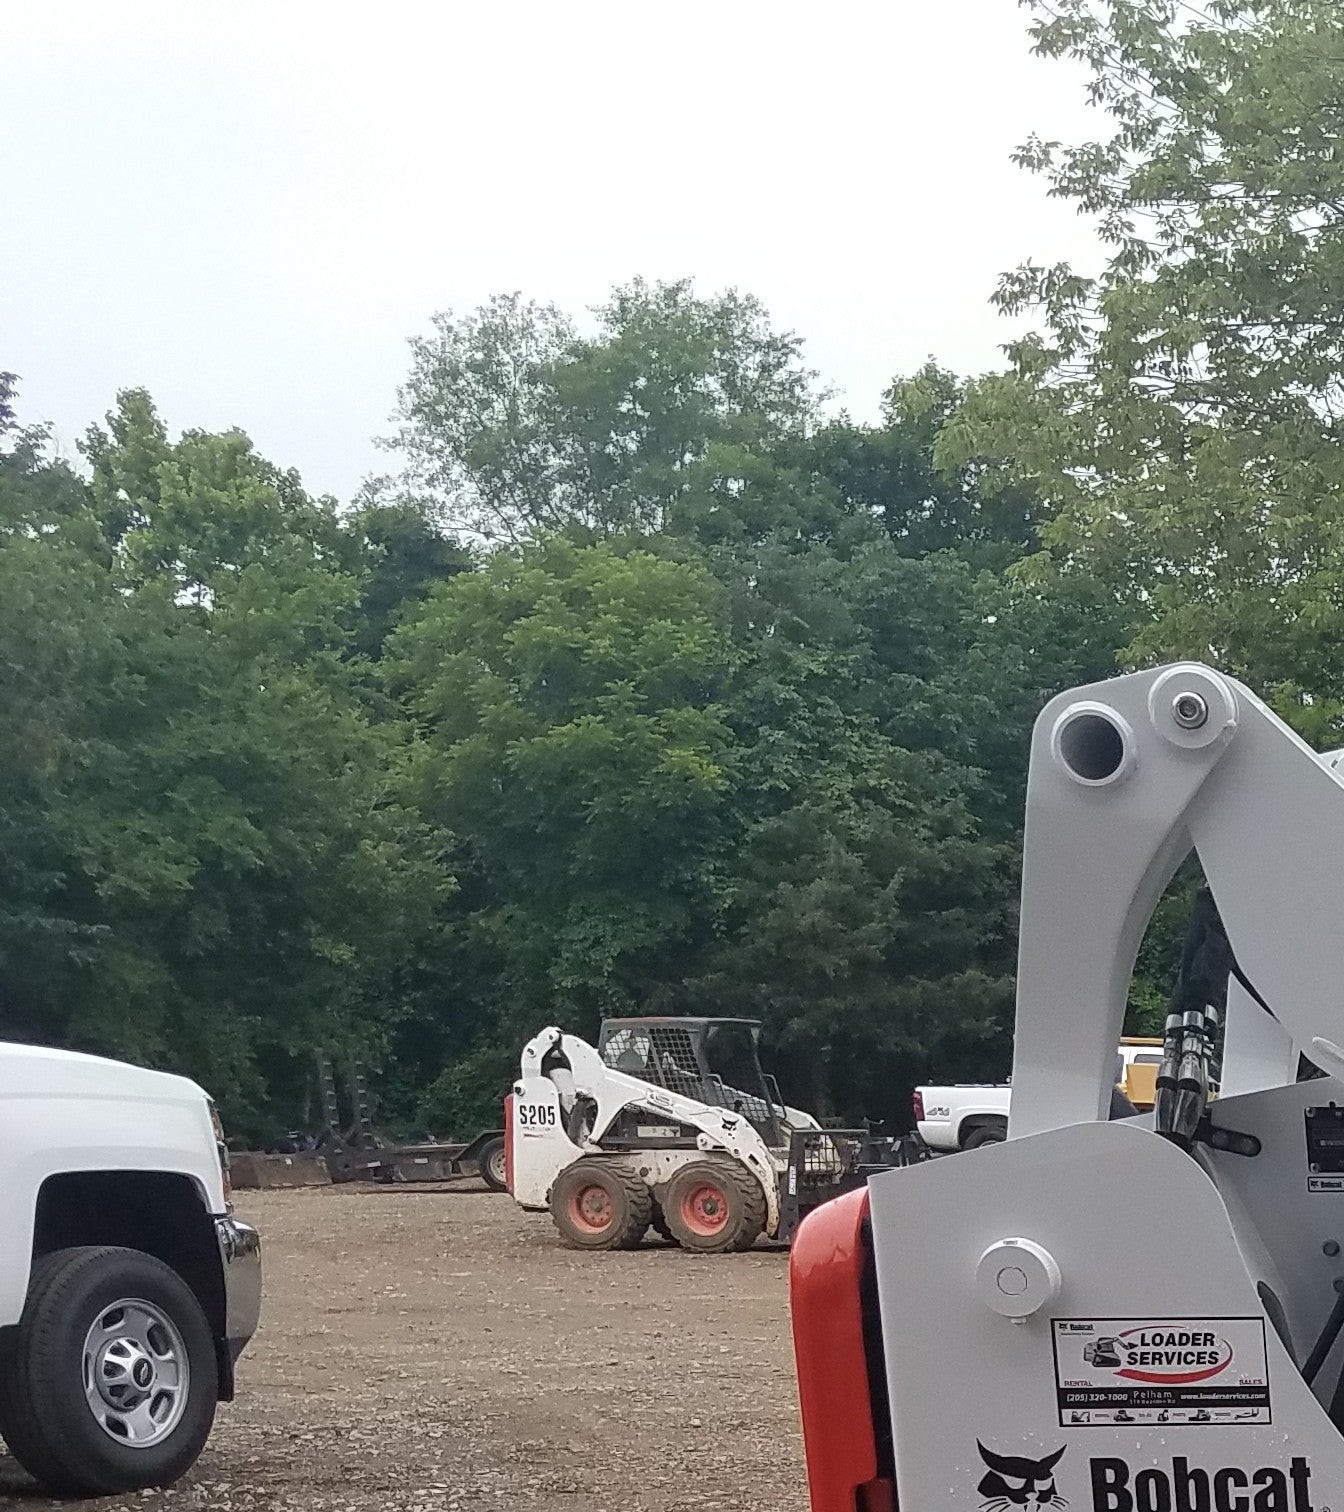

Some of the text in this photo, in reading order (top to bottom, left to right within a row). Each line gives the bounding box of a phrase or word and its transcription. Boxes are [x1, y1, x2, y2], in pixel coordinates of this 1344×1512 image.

[519, 1105, 555, 1125] S205
[1140, 1333, 1215, 1347] LOADER
[1127, 1351, 1219, 1366] SERVICES
[1133, 1390, 1173, 1399] Pelham
